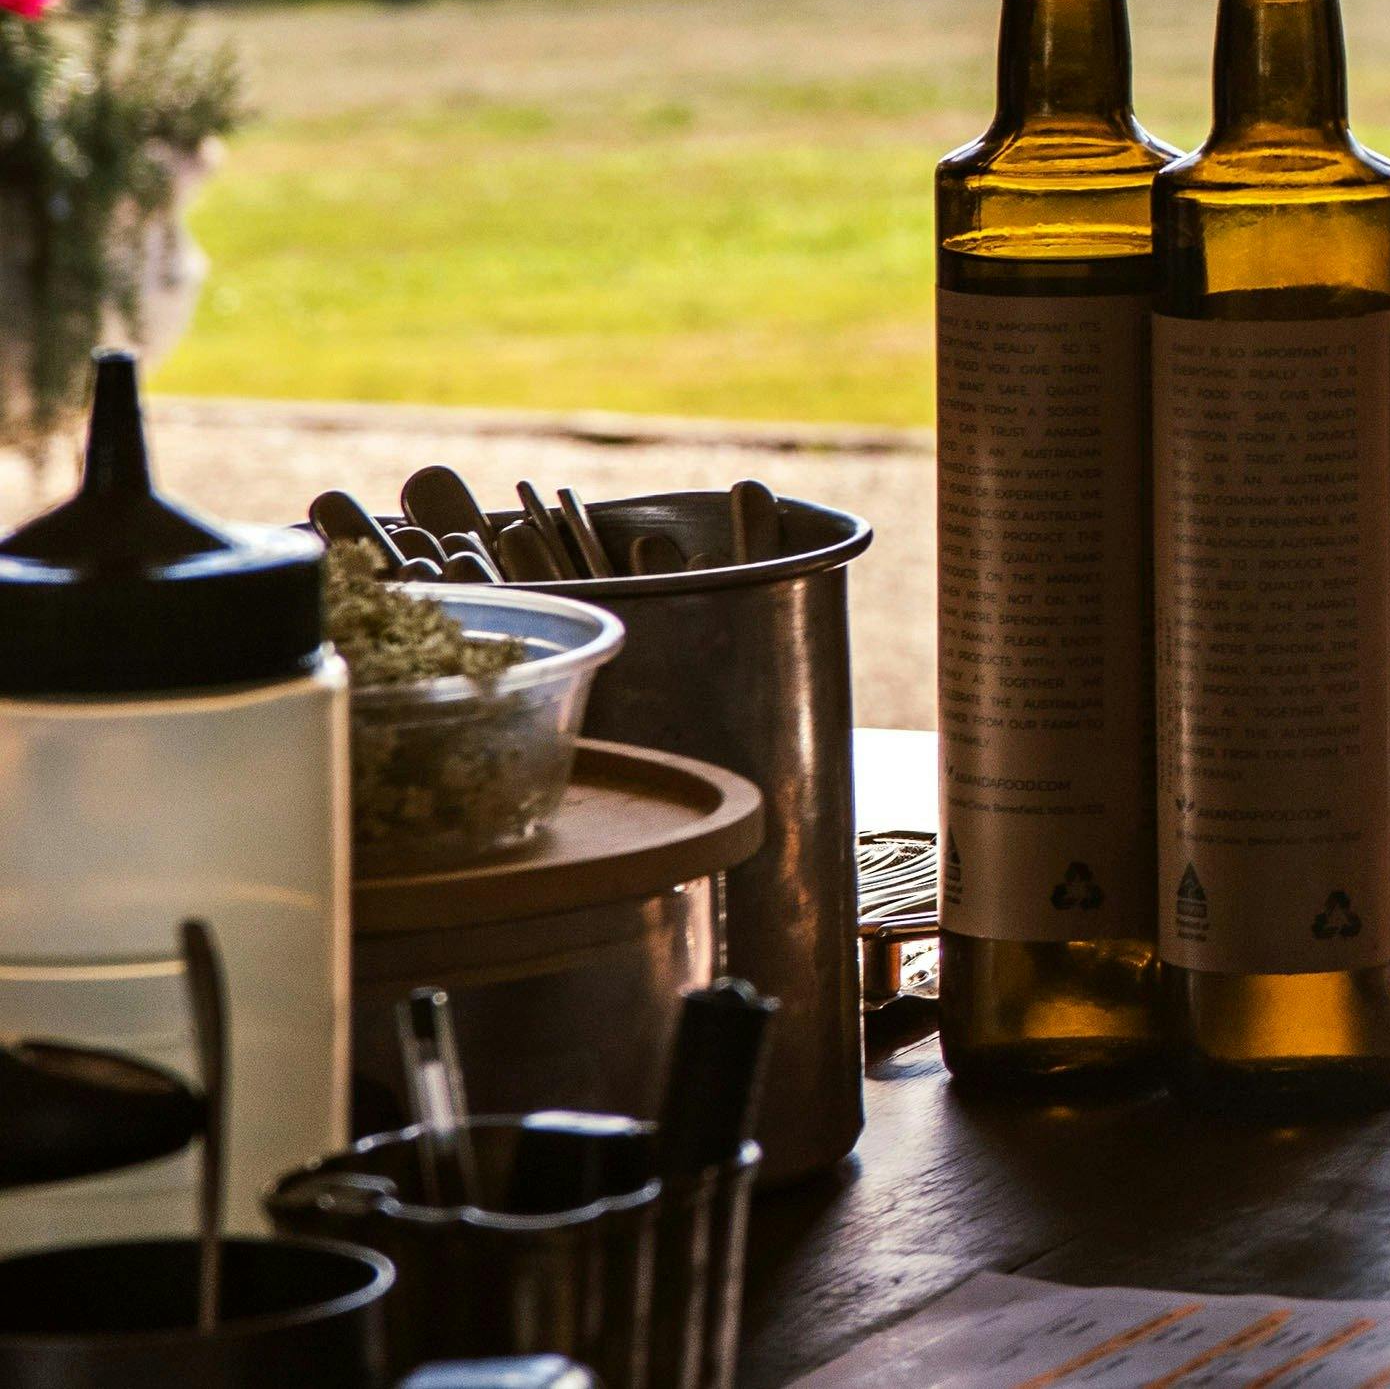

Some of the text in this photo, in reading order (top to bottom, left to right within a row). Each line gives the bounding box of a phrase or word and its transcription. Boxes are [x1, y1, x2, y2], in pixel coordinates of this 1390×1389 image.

[976, 321, 989, 331] SO
[1079, 321, 1101, 332] IT'S
[994, 343, 1038, 354] REALLY
[1062, 344, 1079, 354] SO
[1090, 344, 1101, 354] IS
[986, 364, 1010, 374] YOU
[1020, 365, 1050, 375] GIVE
[1249, 369, 1297, 380] REALLY
[1046, 384, 1102, 397] QUALITY
[1241, 390, 1268, 400] YOU
[1280, 390, 1309, 401] GIVE
[985, 405, 1017, 415] FROM
[1027, 407, 1036, 416] A
[1047, 406, 1100, 417] SOURCE
[1203, 411, 1238, 420] WANT
[1306, 408, 1357, 422] QUALITY
[1045, 427, 1102, 437] ANANDA
[1237, 432, 1275, 442] FROM
[1288, 433, 1296, 442] A
[1306, 429, 1357, 441] SOURCE
[989, 448, 1005, 457] AN
[1021, 449, 1102, 458] AUSTRALIAN
[1204, 453, 1228, 463] CAN
[1305, 450, 1357, 463] ANANDA
[968, 466, 1021, 479] COMPANY
[1027, 469, 1059, 479] WITH
[1067, 468, 1102, 479] OVER
[1244, 476, 1261, 484] AN
[1281, 472, 1359, 485] AUSTRALIAN
[1081, 490, 1104, 500] WE
[1214, 495, 1278, 506] COMPANY
[1287, 495, 1319, 506] WITH
[1325, 493, 1359, 504] OVER
[961, 507, 1103, 521] ALONGSIDE AUSTRALIAN
[1226, 517, 1242, 527] OF
[1340, 512, 1359, 524] WE
[979, 530, 992, 540] TO
[1003, 531, 1064, 543] PRODUCE
[1206, 538, 1274, 549] ALONGSIDE
[1281, 534, 1359, 549] AUSTRALIAN
[970, 549, 993, 560] BEST
[1002, 552, 1051, 564] QUALITY
[1064, 551, 1104, 563] HEMP
[1232, 559, 1246, 570] TO
[1260, 558, 1324, 570] PRODUCE
[987, 572, 1002, 582] ON
[1012, 573, 1035, 584] THE
[1217, 580, 1247, 591] BEST
[1258, 580, 1313, 592] QUALITY
[1008, 594, 1032, 604] NOT
[1045, 595, 1066, 605] ON
[1079, 594, 1102, 604] THE
[1240, 600, 1258, 612] ON
[1270, 601, 1293, 611] THE
[999, 615, 1064, 626] SPENDING
[1073, 614, 1104, 625] TIME
[1264, 622, 1292, 633] NOT
[1305, 622, 1324, 632] ON
[1336, 618, 1358, 629] THE
[1004, 635, 1048, 647] PLEASE
[1061, 635, 1102, 647] ENJOY
[1255, 643, 1324, 655] SPENDING
[1331, 640, 1358, 651] TIME
[959, 651, 1104, 668] PRODUCTS WITH YOUR
[1260, 665, 1308, 675] PLEASE
[1321, 661, 1359, 673] ENJOY
[1000, 677, 1064, 689] TOGETHER
[1203, 684, 1268, 696] PRODUCTS
[1280, 686, 1315, 696] WITH
[1325, 681, 1359, 693] YOUR
[992, 698, 1103, 710] THE AUSTRALIAN
[1254, 706, 1324, 718] TOGETHER
[973, 716, 1003, 727] FROM
[1009, 719, 1036, 730] OUR
[1042, 720, 1079, 729] FARM
[1087, 719, 1104, 729] TO
[1245, 728, 1268, 739] THE
[1281, 725, 1359, 738] AUSTRALIAN
[1223, 749, 1259, 759] FROM
[1267, 750, 1296, 759] OUR
[1303, 747, 1338, 758] FARM
[1346, 745, 1360, 755] TO
[955, 773, 1071, 791] ANANDAFOOD.COM
